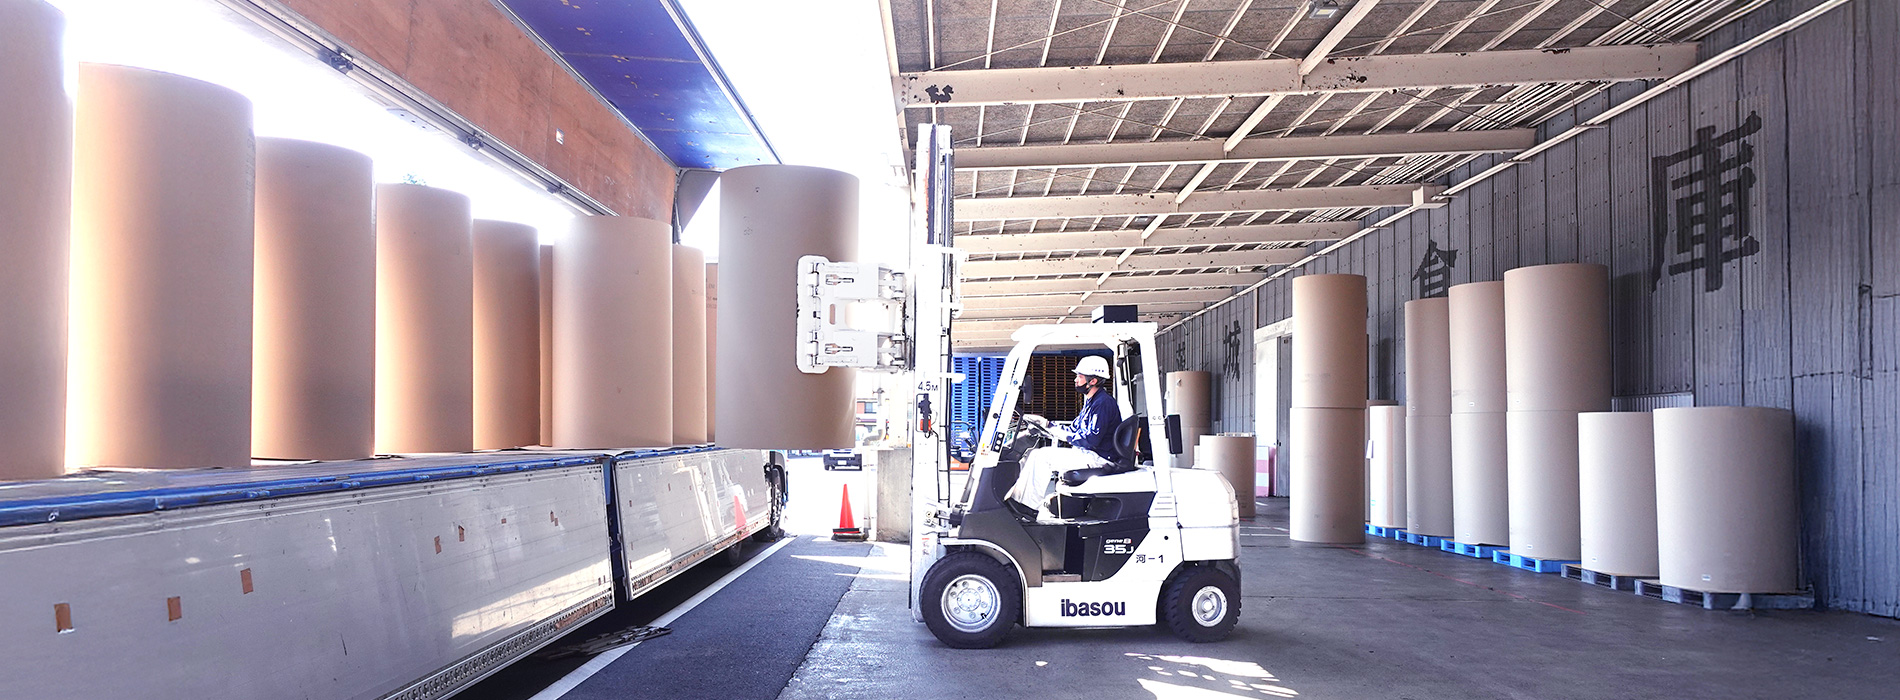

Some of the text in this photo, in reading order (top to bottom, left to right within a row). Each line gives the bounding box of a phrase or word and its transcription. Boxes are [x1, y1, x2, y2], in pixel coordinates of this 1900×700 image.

[1651, 110, 1762, 293] 庫
[1103, 544, 1134, 554] 35J
[1061, 599, 1126, 617] ibasou
